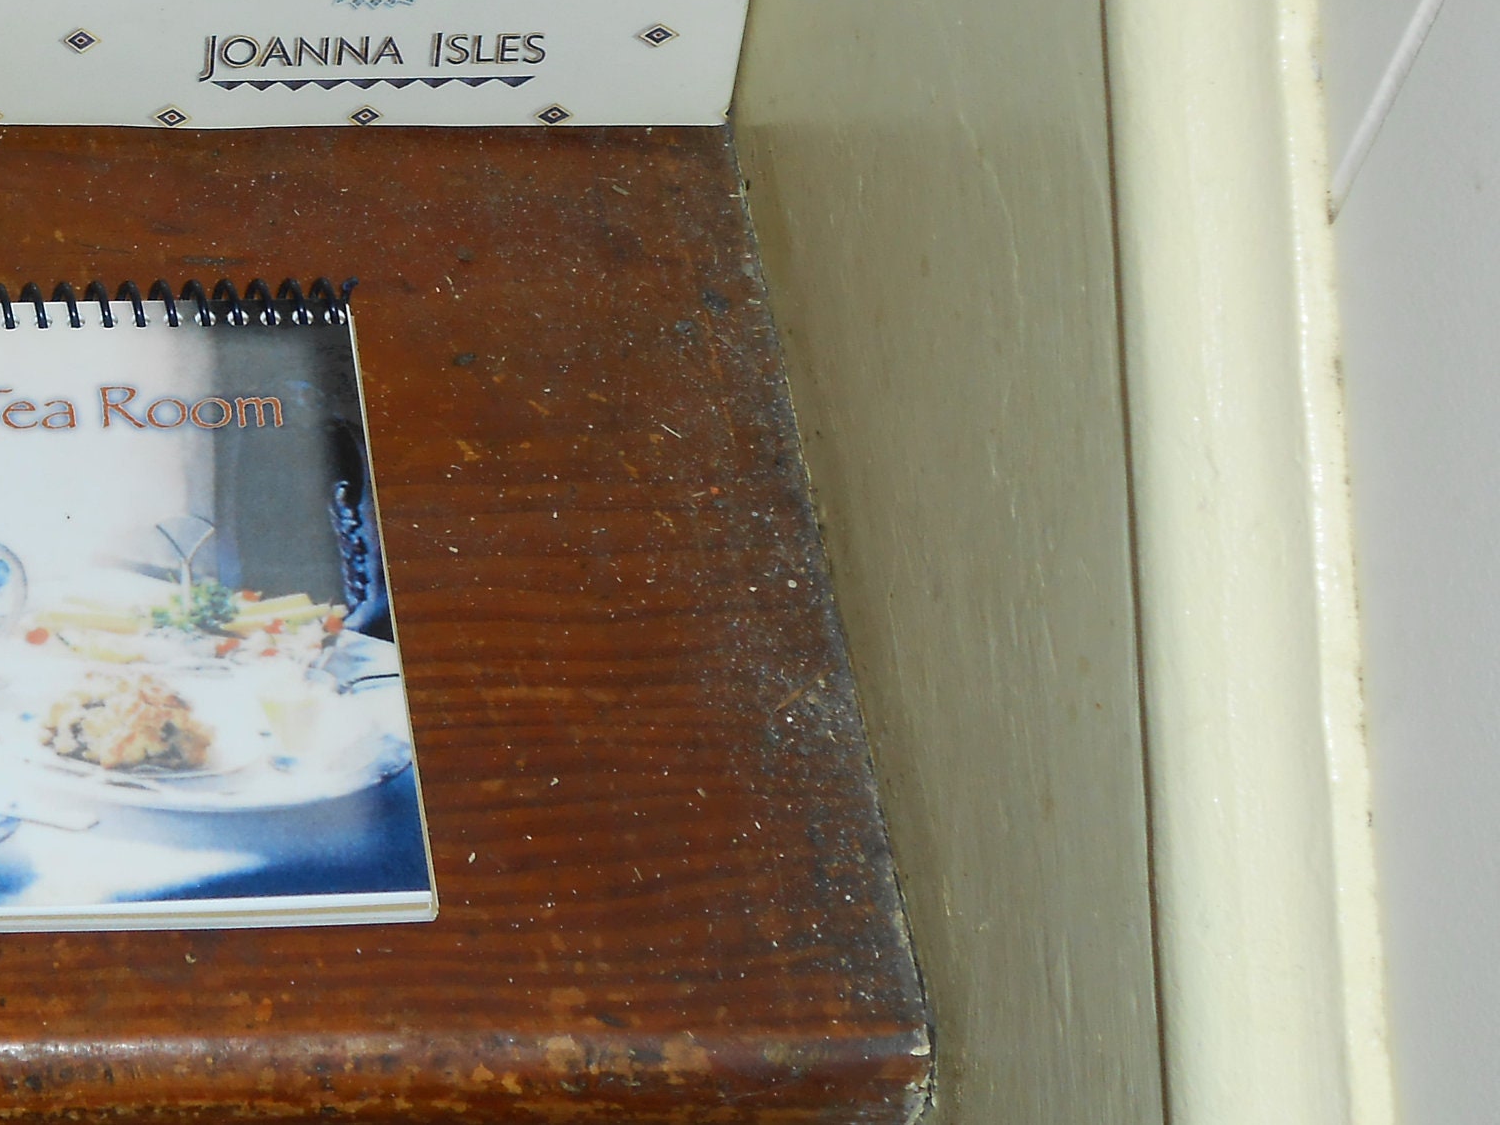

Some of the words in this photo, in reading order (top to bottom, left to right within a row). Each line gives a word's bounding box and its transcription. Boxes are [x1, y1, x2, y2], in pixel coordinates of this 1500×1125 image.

[200, 35, 404, 82] JOANNA
[430, 32, 547, 68] ISLES
[100, 385, 285, 429] Room
